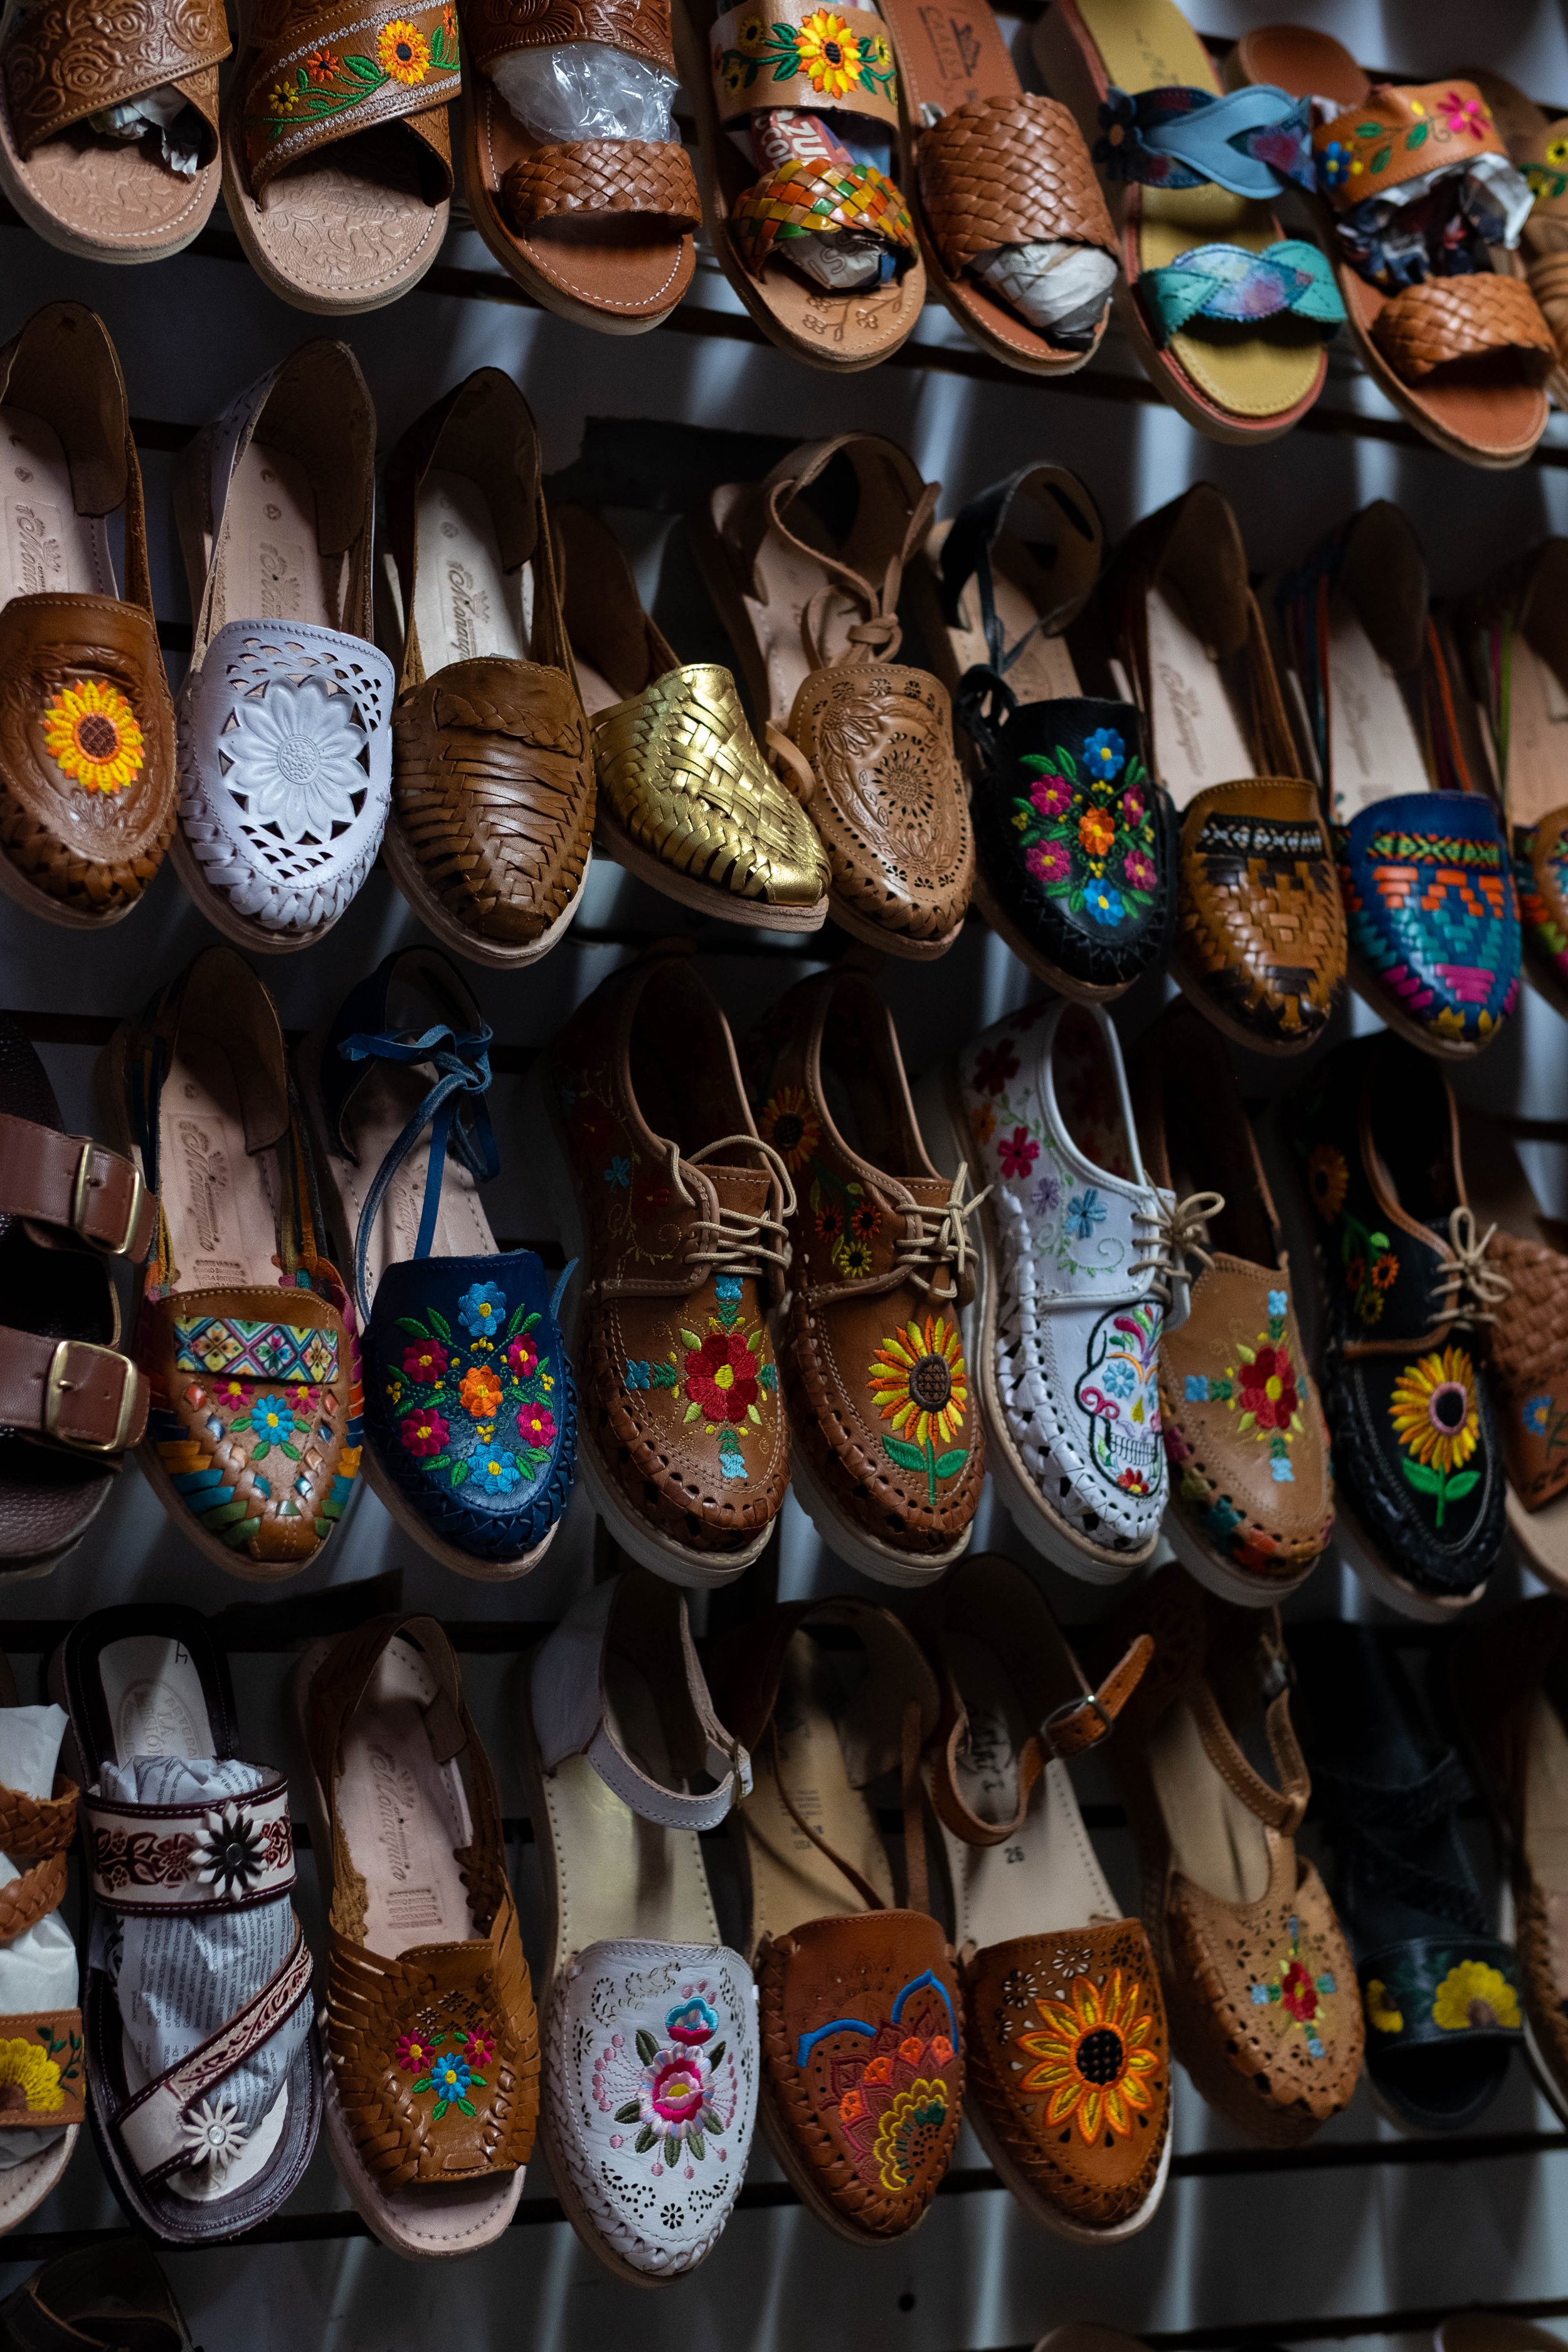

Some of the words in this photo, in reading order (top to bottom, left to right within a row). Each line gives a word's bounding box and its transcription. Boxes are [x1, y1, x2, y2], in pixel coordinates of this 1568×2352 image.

[1004, 1845, 1025, 1863] 26
[268, 1919, 274, 1929] de
[152, 1924, 162, 1954] algunos
[232, 1932, 238, 1941] de
[210, 1928, 218, 1975] Comisionado.
[248, 1948, 255, 1957] de
[267, 1947, 273, 1955] de
[150, 1956, 156, 1964] en
[156, 1980, 164, 2006] realizan
[161, 1952, 167, 1961] de
[209, 1976, 218, 1991] Alto
[219, 1972, 228, 2004] conexión
[174, 2004, 182, 2028] oficios
